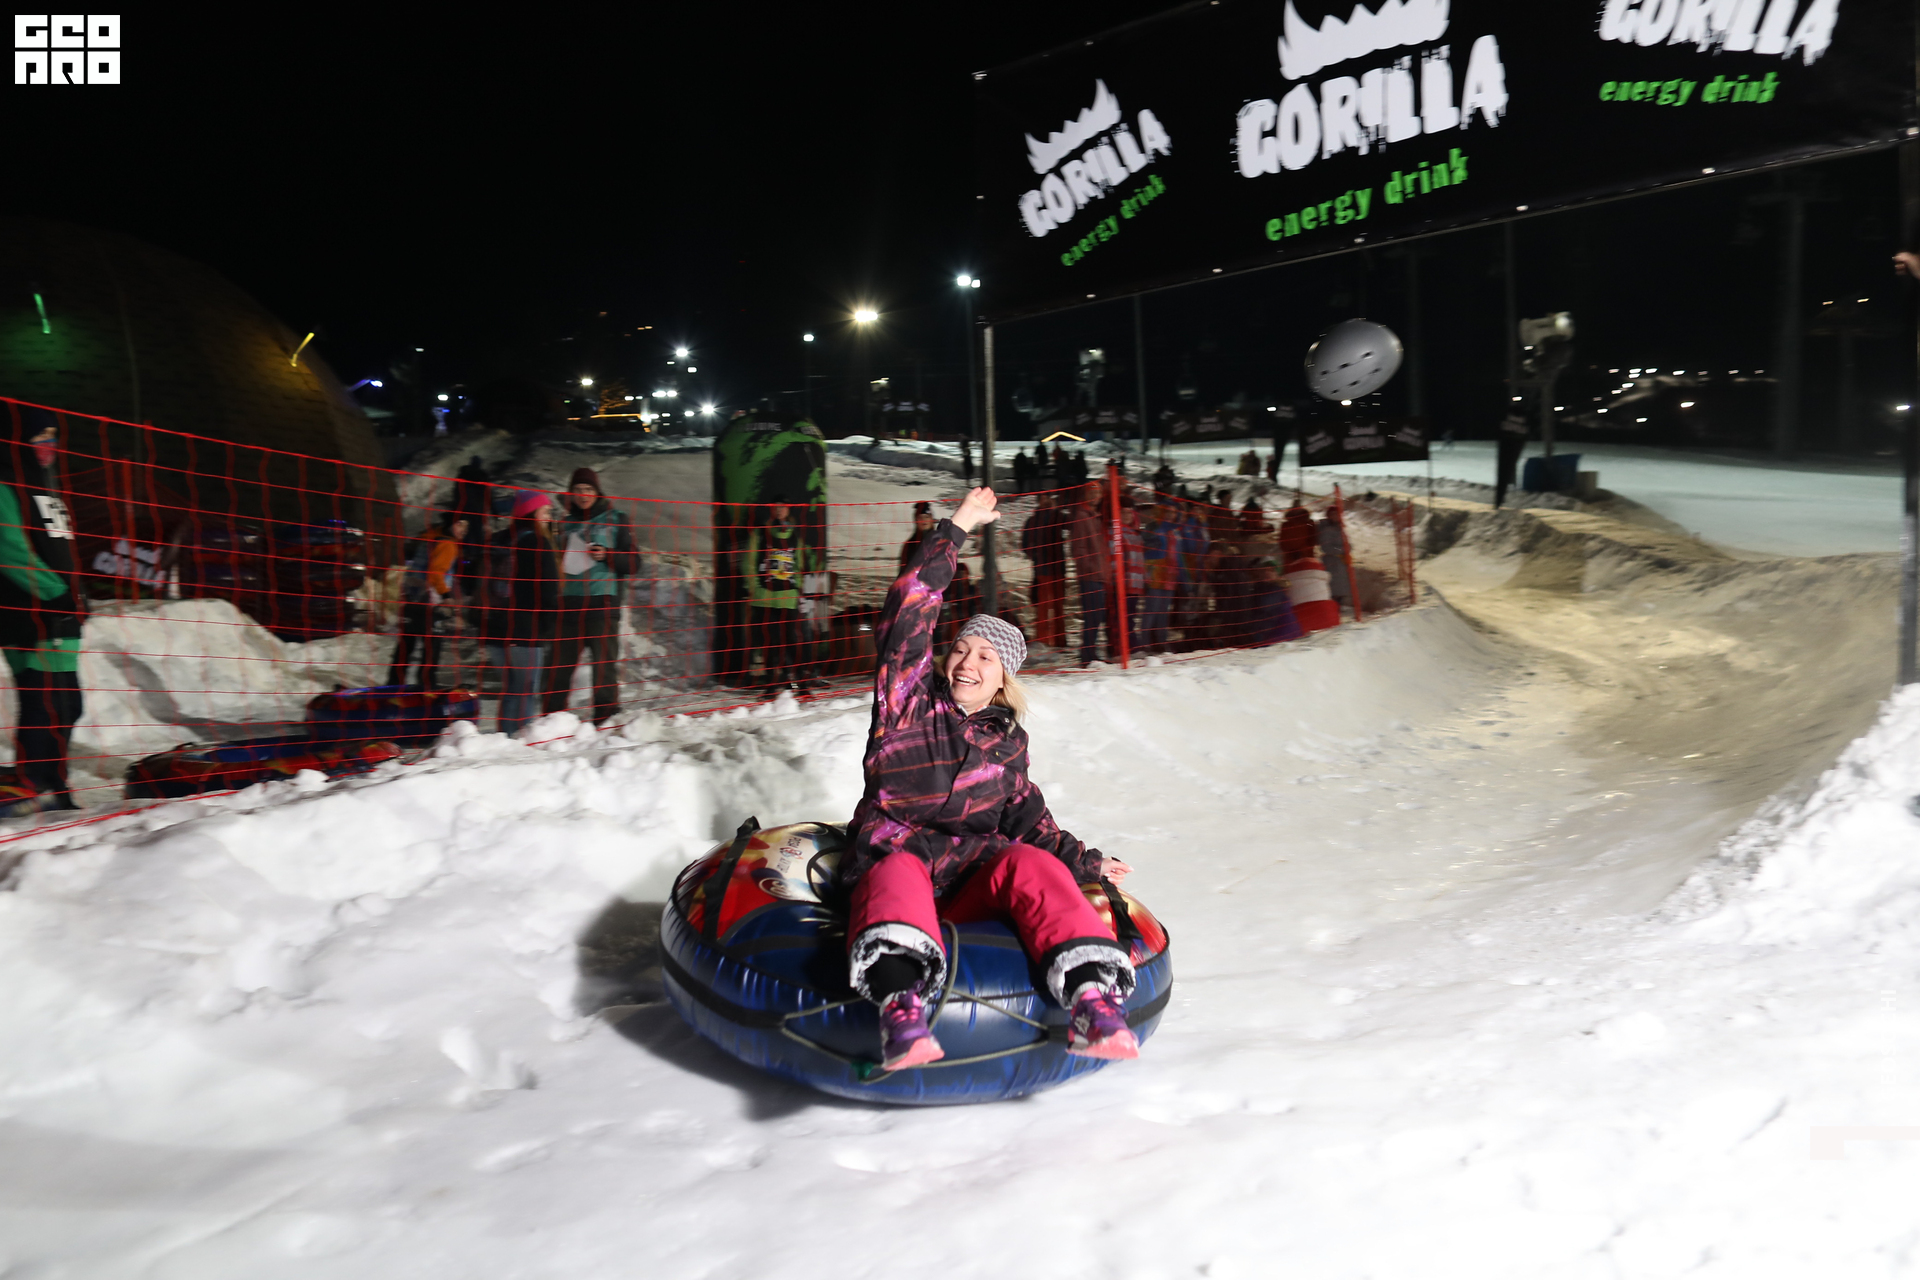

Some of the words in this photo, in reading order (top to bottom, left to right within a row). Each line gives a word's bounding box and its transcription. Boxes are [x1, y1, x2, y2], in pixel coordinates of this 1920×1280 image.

[1230, 34, 1509, 178] GORILLA
[1600, 78, 1697, 107] energy
[1702, 72, 1781, 104] drink
[1018, 109, 1172, 238] GORILLA
[1061, 215, 1119, 266] energy
[1120, 174, 1166, 219] drink
[1265, 187, 1372, 242] energy
[1384, 147, 1469, 205] drink
